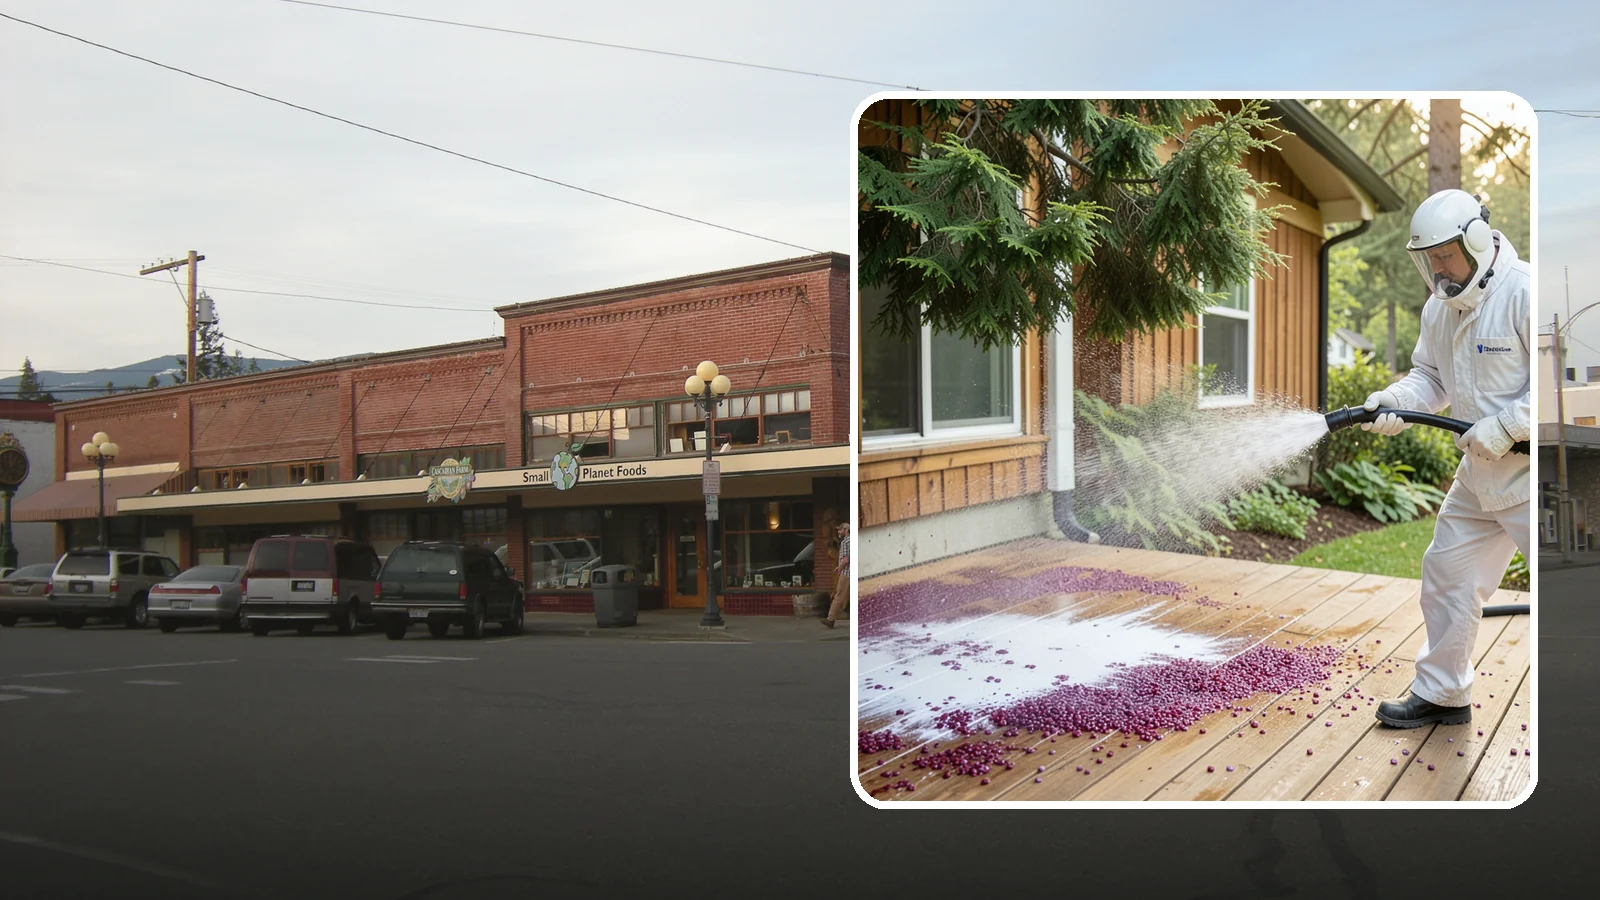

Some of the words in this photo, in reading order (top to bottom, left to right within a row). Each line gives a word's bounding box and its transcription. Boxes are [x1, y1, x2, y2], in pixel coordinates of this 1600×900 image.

[523, 471, 549, 483] Small
[582, 468, 614, 479] Planet
[617, 464, 647, 477] Foods
